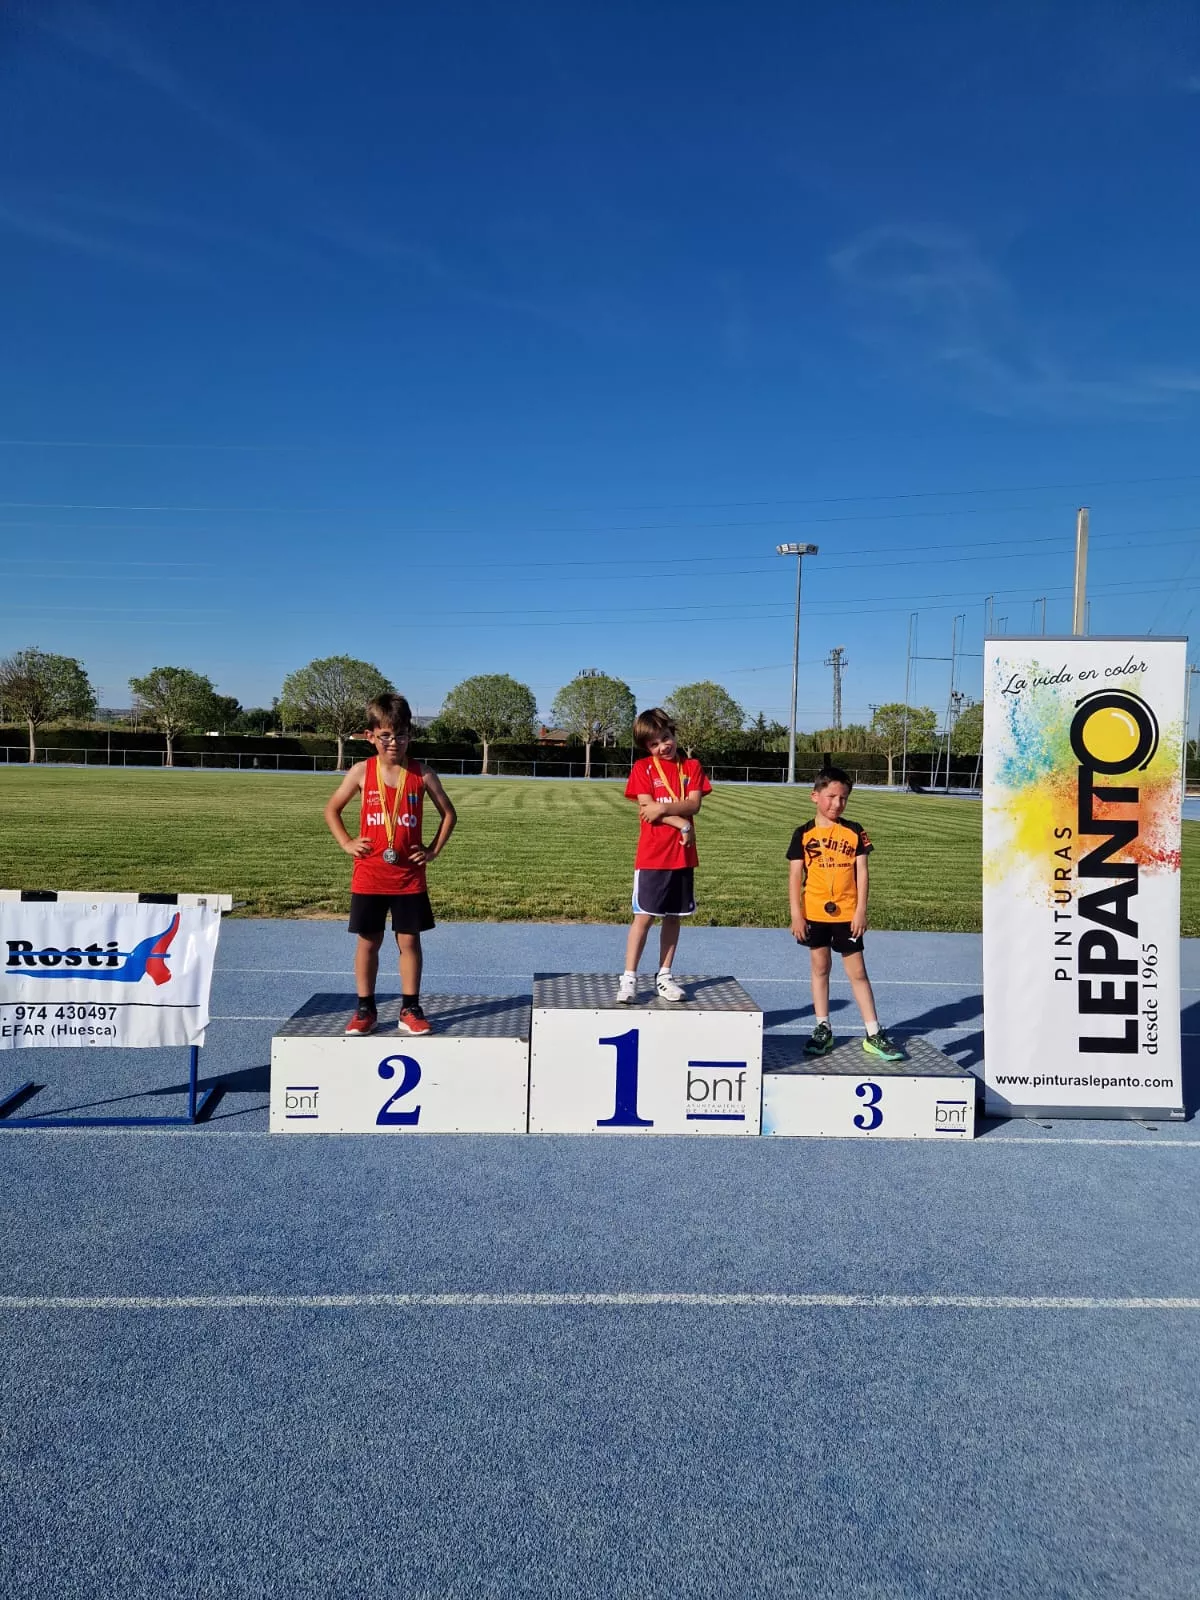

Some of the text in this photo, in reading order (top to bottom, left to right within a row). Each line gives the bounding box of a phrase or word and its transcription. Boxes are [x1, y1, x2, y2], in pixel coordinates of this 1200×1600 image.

[1001, 655, 1149, 695] La vida en color
[1070, 688, 1159, 1055] LEPANTO
[1054, 826, 1073, 981] PINTURAS
[6, 940, 119, 967] Rosti
[15, 1006, 117, 1020] 974 430497
[1142, 942, 1159, 1055] desde 1965
[2, 1024, 117, 1038] EFAR (Huesca)
[376, 1054, 422, 1126] 2
[596, 1029, 654, 1127] 1
[686, 1071, 747, 1102] bnf
[995, 1074, 1174, 1089] www.pinturaslepanto.com
[285, 1091, 320, 1109] bnf
[853, 1082, 884, 1131] 3
[935, 1105, 968, 1122] bnf
